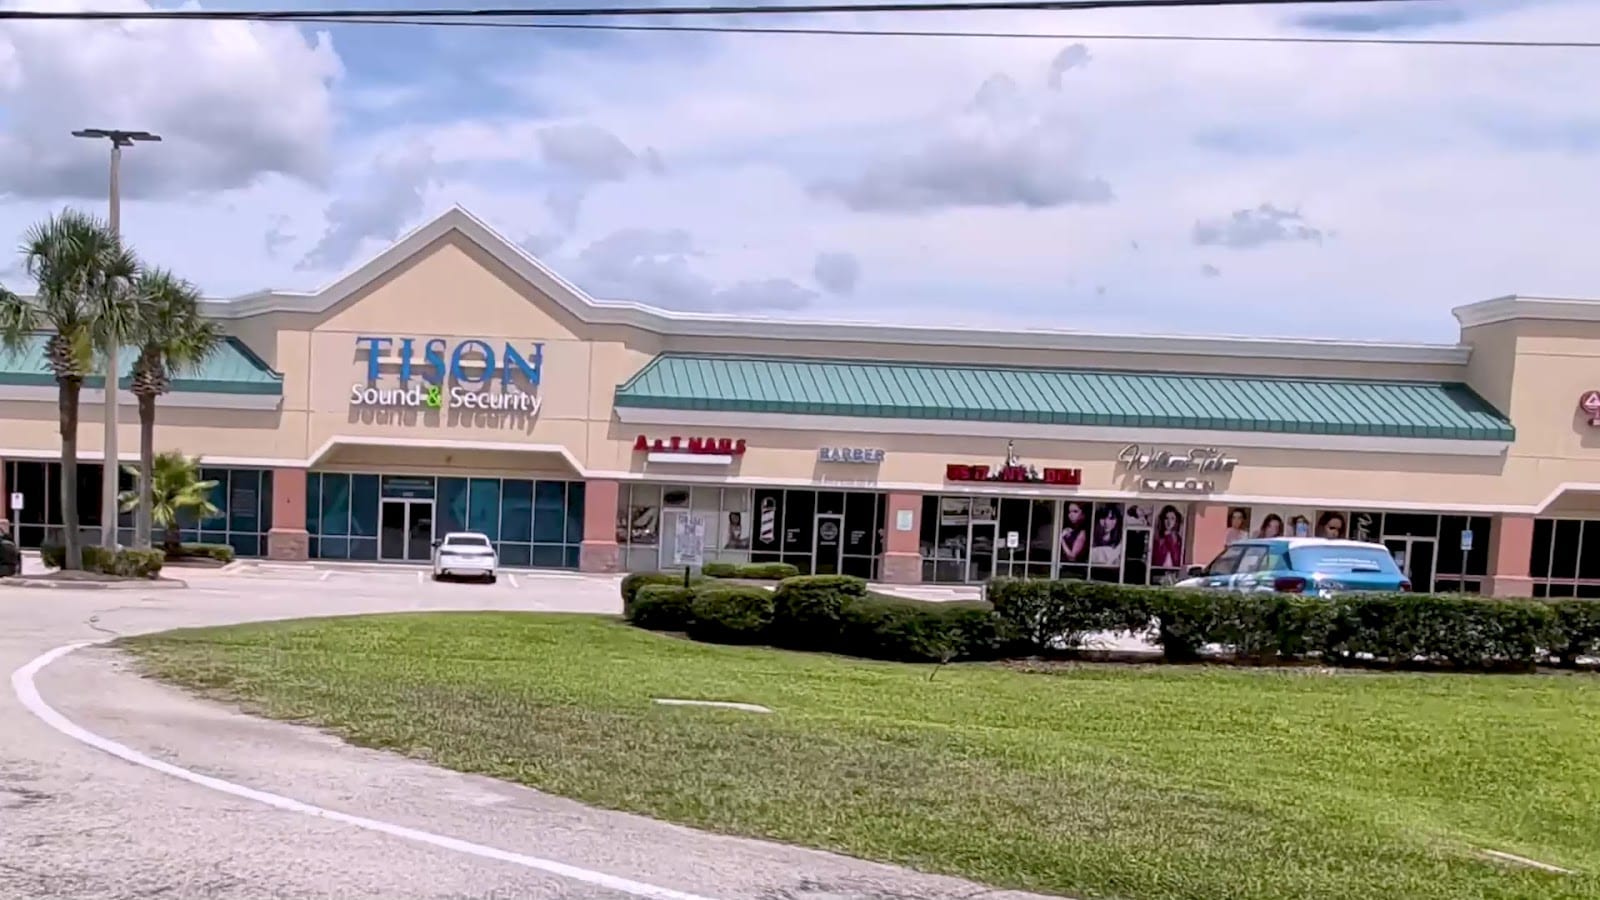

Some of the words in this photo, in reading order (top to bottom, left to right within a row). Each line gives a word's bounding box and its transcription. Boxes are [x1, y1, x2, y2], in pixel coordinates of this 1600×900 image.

[355, 336, 546, 387] TISON
[350, 384, 420, 407] Sound
[426, 385, 441, 408] &
[450, 387, 542, 416] Security
[819, 446, 886, 463] BARBER
[1141, 478, 1216, 491] SALON
